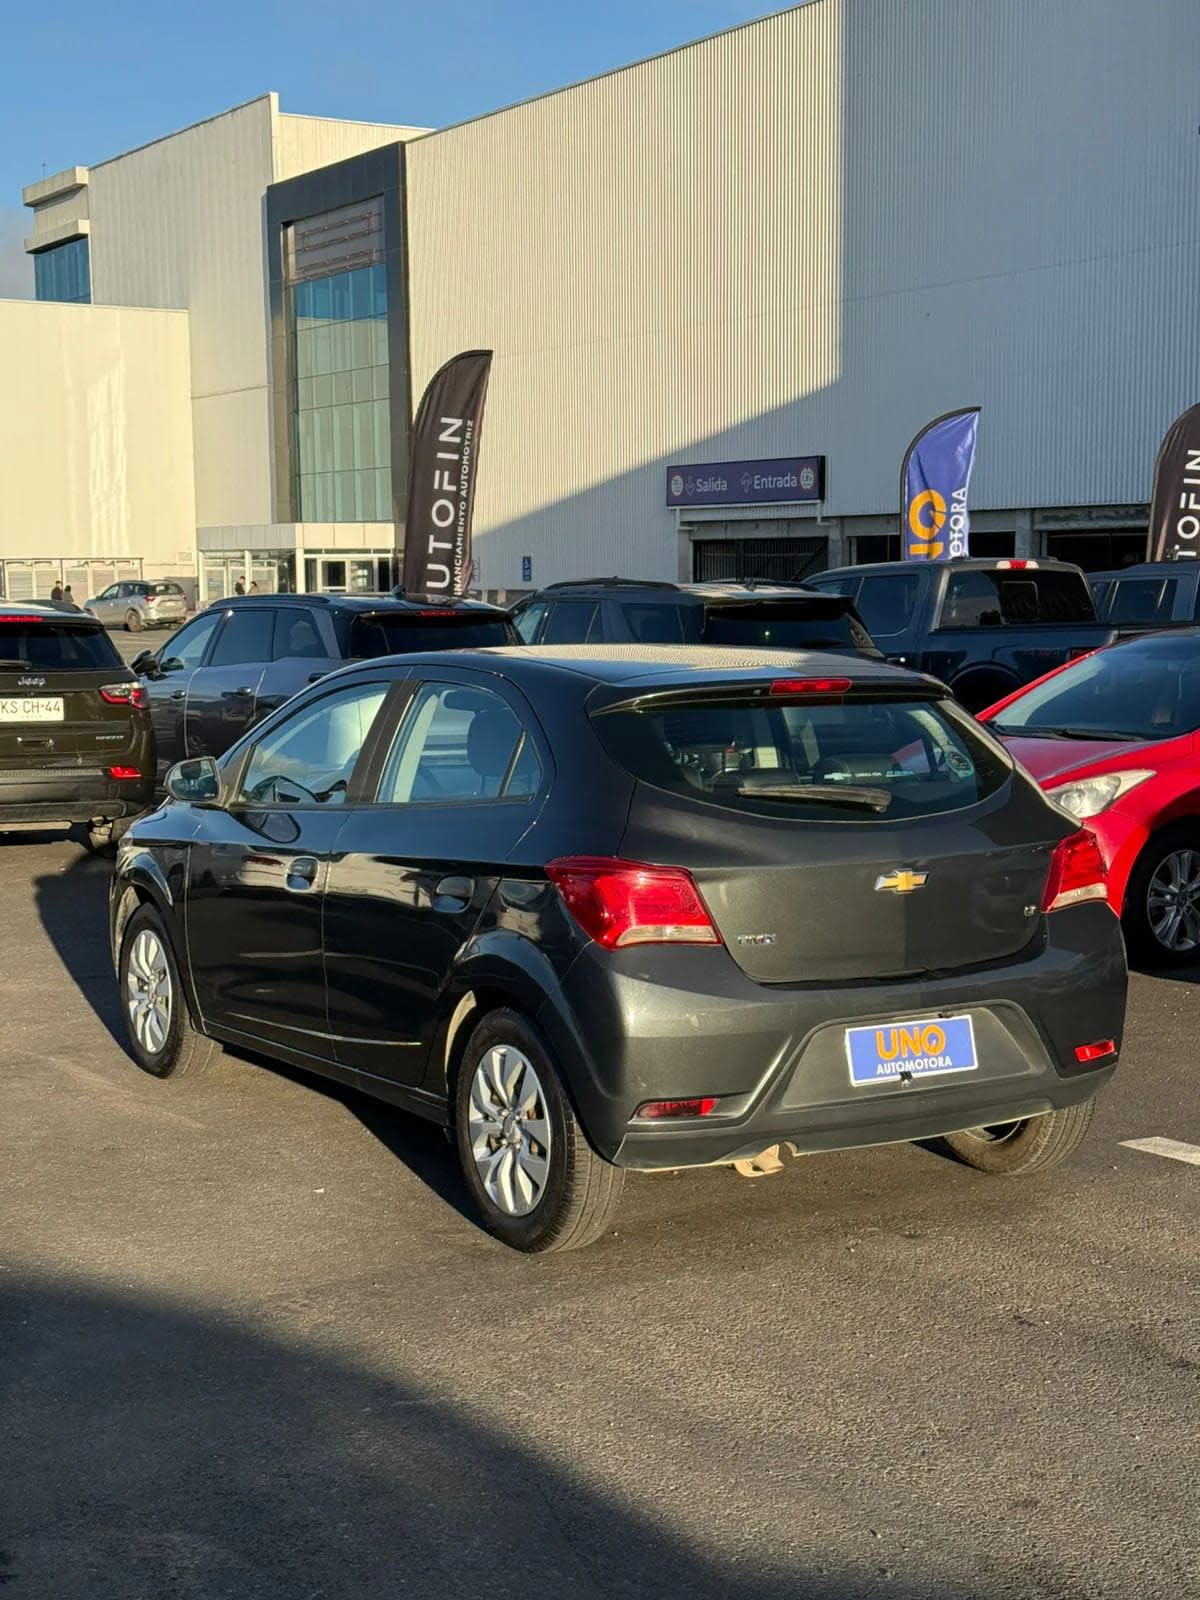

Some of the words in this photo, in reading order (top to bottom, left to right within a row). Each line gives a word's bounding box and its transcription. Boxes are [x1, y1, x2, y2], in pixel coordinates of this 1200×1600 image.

[426, 417, 462, 589] UTOFIN
[453, 501, 467, 596] INANCIAMIENTO
[460, 419, 474, 498] AUTOMOTRIZ
[696, 476, 728, 492] Salida
[753, 472, 798, 489] Entrada
[947, 487, 968, 560] OTORA
[875, 1024, 946, 1061] UNO
[876, 1055, 953, 1075] AUTOMOTORA
